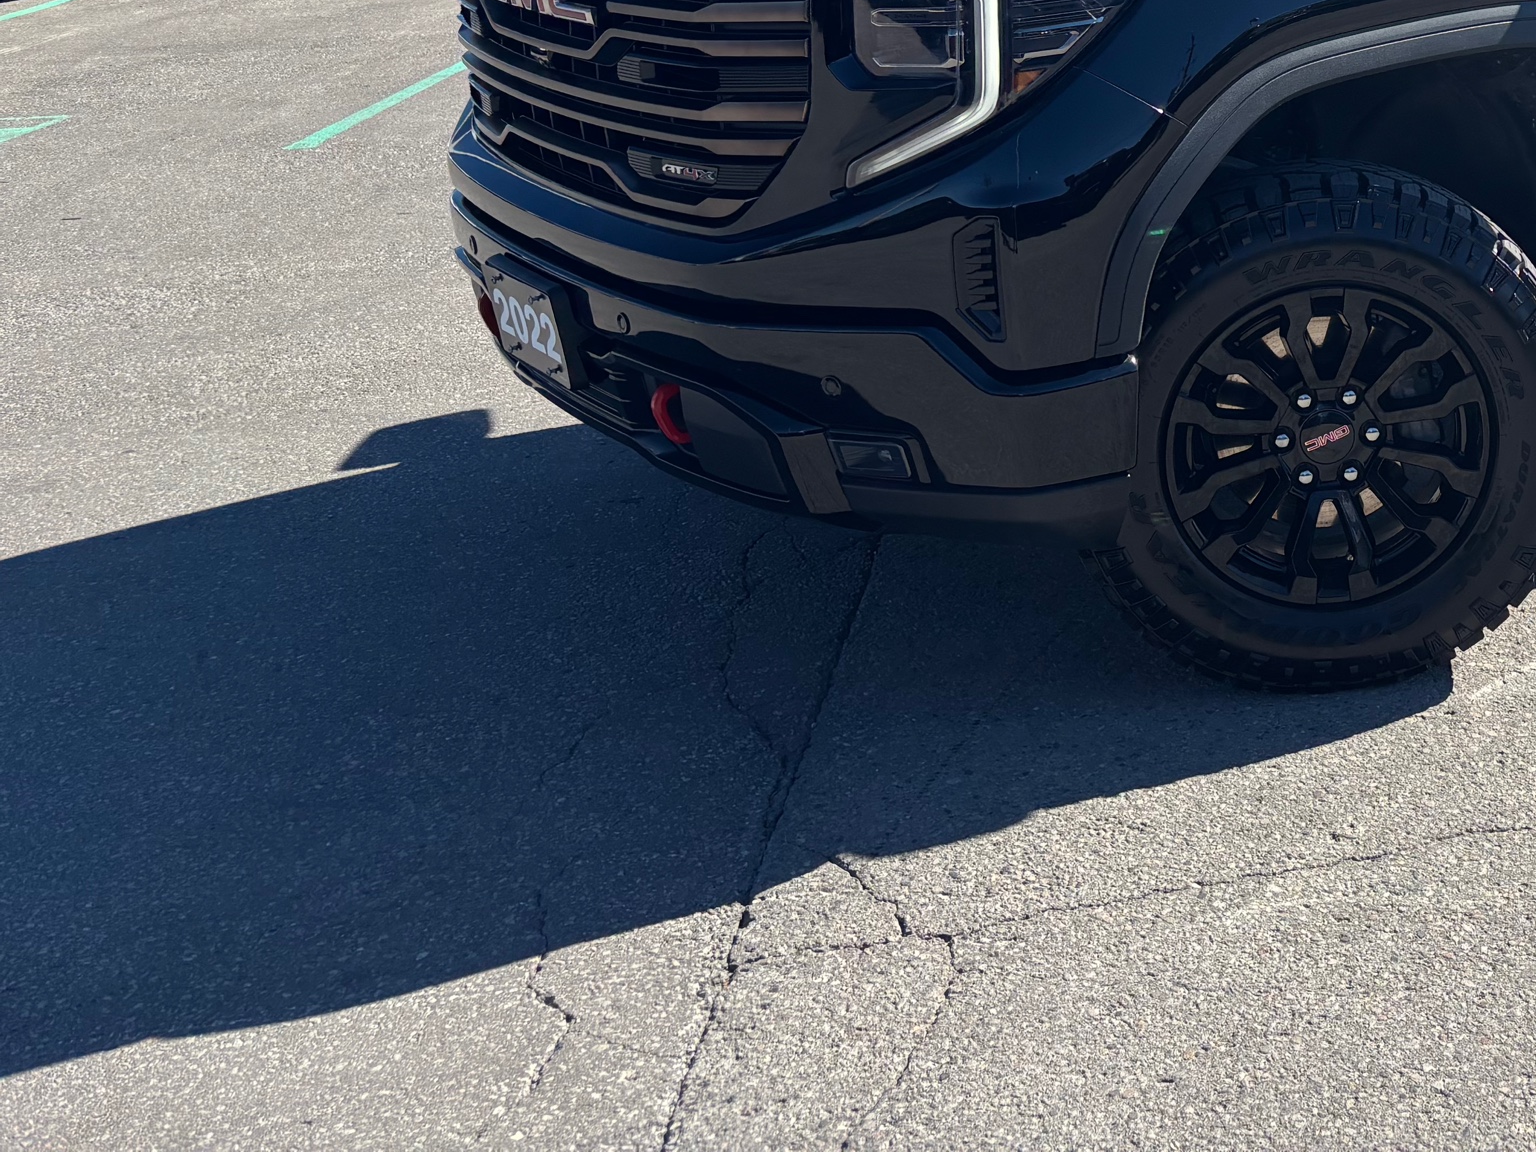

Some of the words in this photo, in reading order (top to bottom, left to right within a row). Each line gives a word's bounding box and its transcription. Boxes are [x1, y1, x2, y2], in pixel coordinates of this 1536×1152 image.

[661, 163, 715, 181] AT4X
[493, 287, 563, 364] 2022
[1241, 248, 1526, 401] WRANGLER
[1304, 424, 1351, 452] GMC
